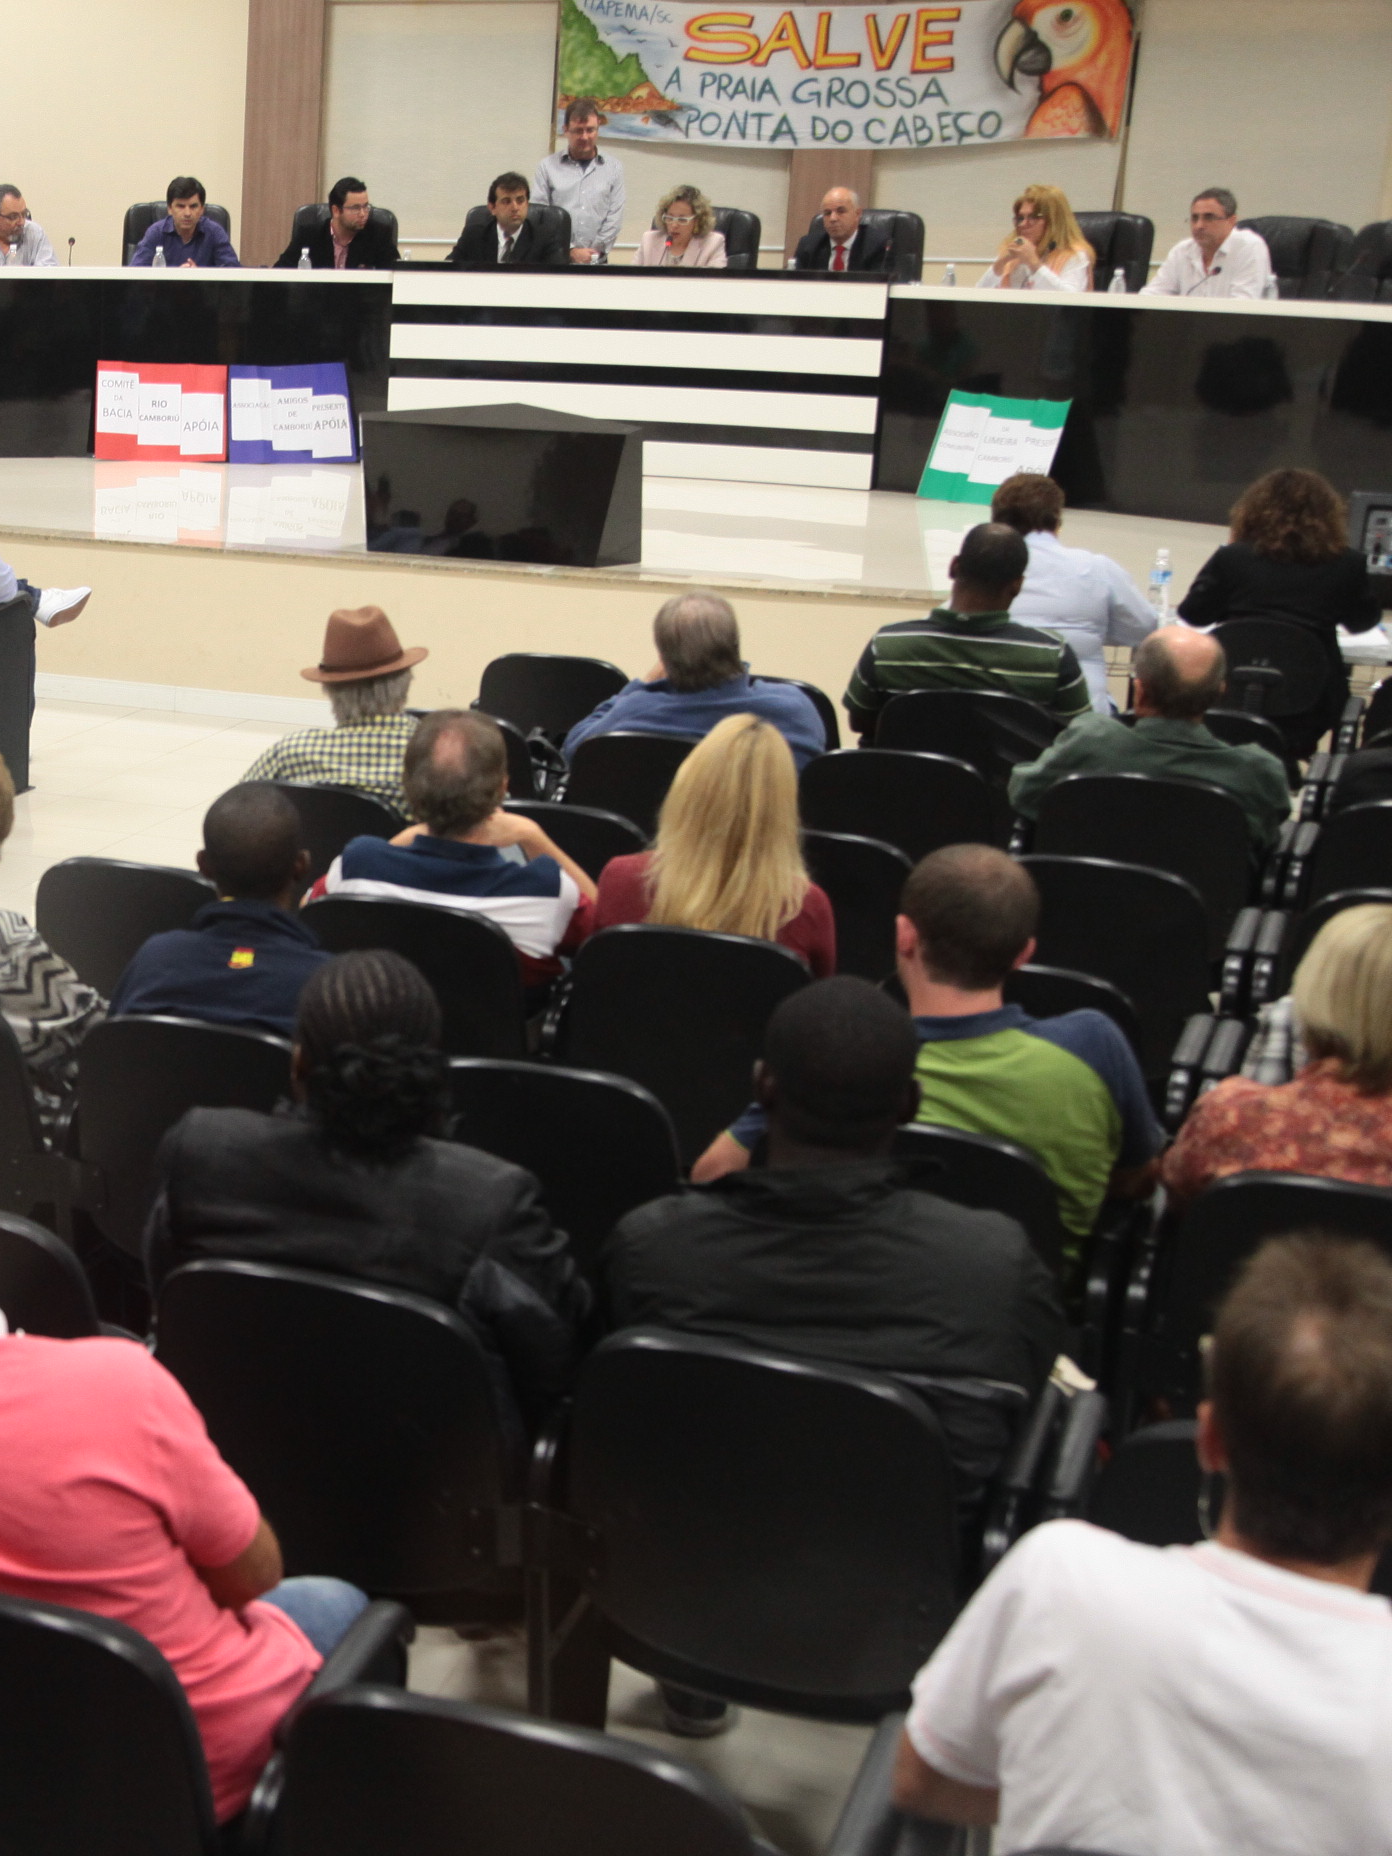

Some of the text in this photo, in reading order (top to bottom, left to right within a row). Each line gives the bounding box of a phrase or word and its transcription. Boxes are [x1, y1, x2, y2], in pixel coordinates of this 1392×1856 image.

[682, 7, 961, 75] SALVE
[664, 66, 950, 109] A PRAIA GROSSA
[683, 107, 1003, 146] PONTA DO CABEÇO
[151, 400, 168, 409] RIO
[102, 408, 133, 419] BACIA
[183, 418, 220, 432] APÓIA
[313, 416, 349, 431] APÓIA
